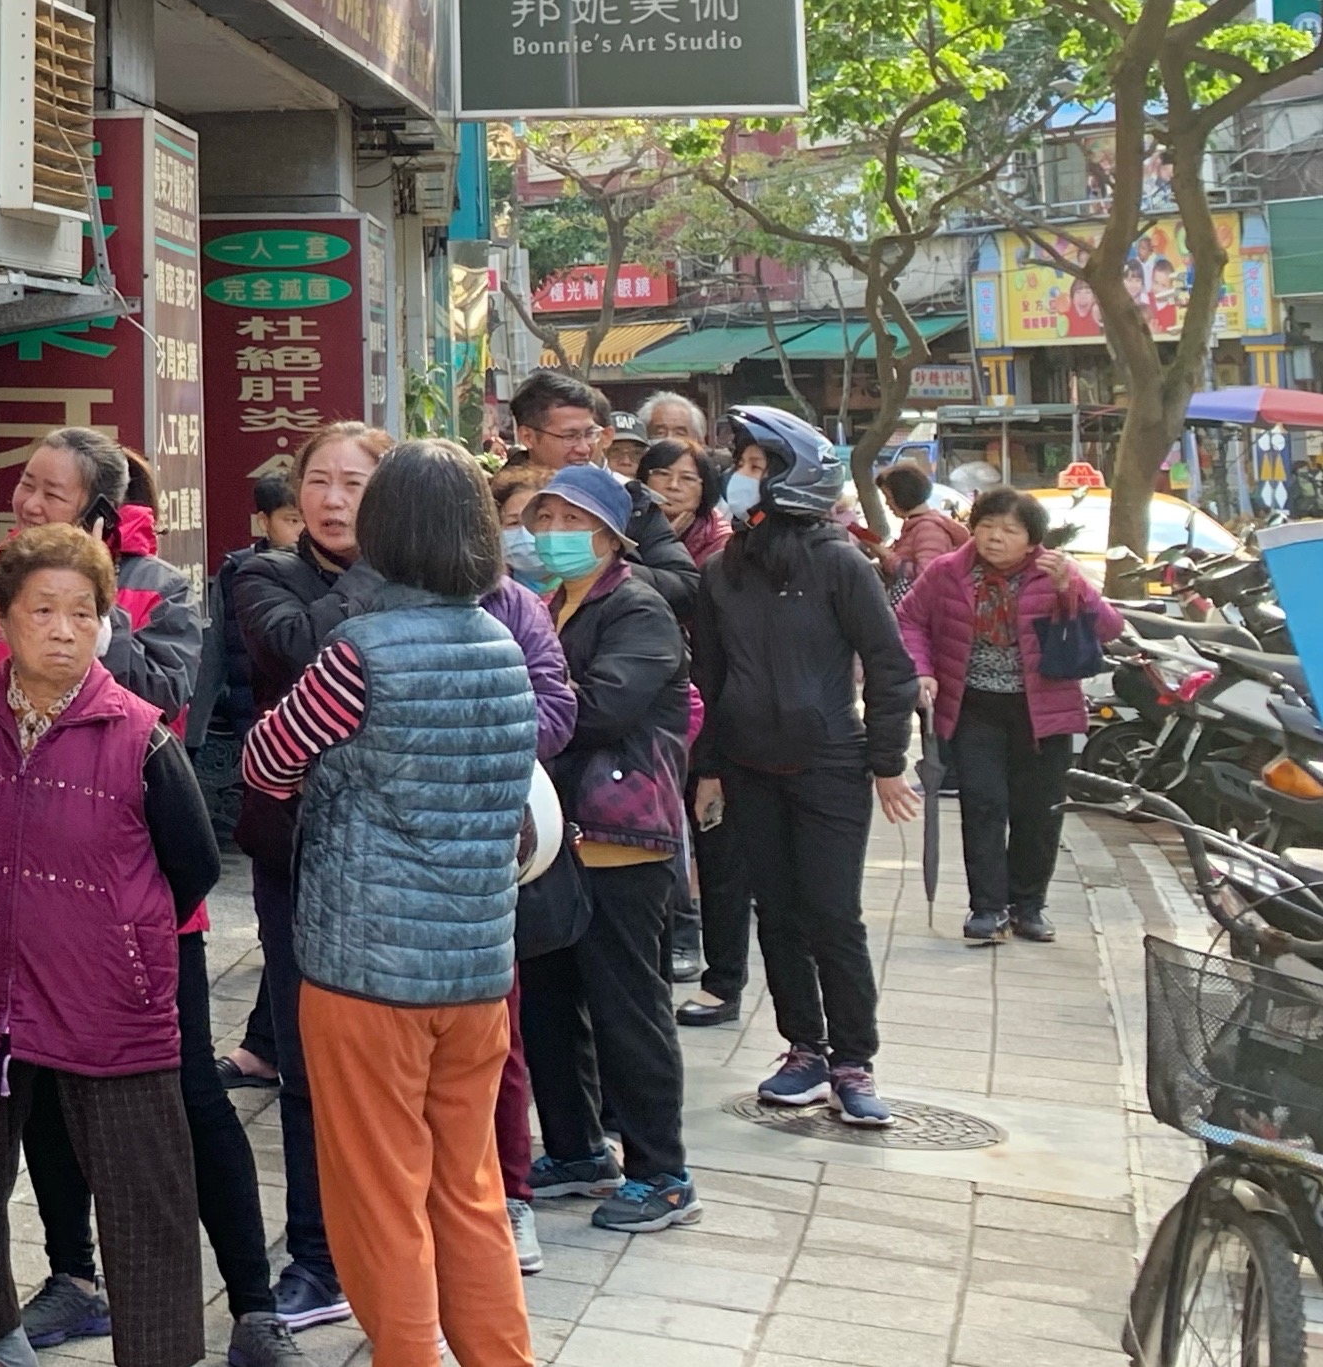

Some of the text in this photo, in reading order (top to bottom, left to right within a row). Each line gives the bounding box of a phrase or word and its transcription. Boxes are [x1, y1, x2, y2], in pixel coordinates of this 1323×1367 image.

[513, 29, 743, 56] Bonnie's Art Studio
[221, 236, 329, 260] 一人一套
[222, 278, 332, 302] 完全滅菌
[549, 276, 651, 302] 極光精眼鏡
[235, 316, 324, 432] 杜絕肝炎
[157, 412, 199, 455] 人工植牙
